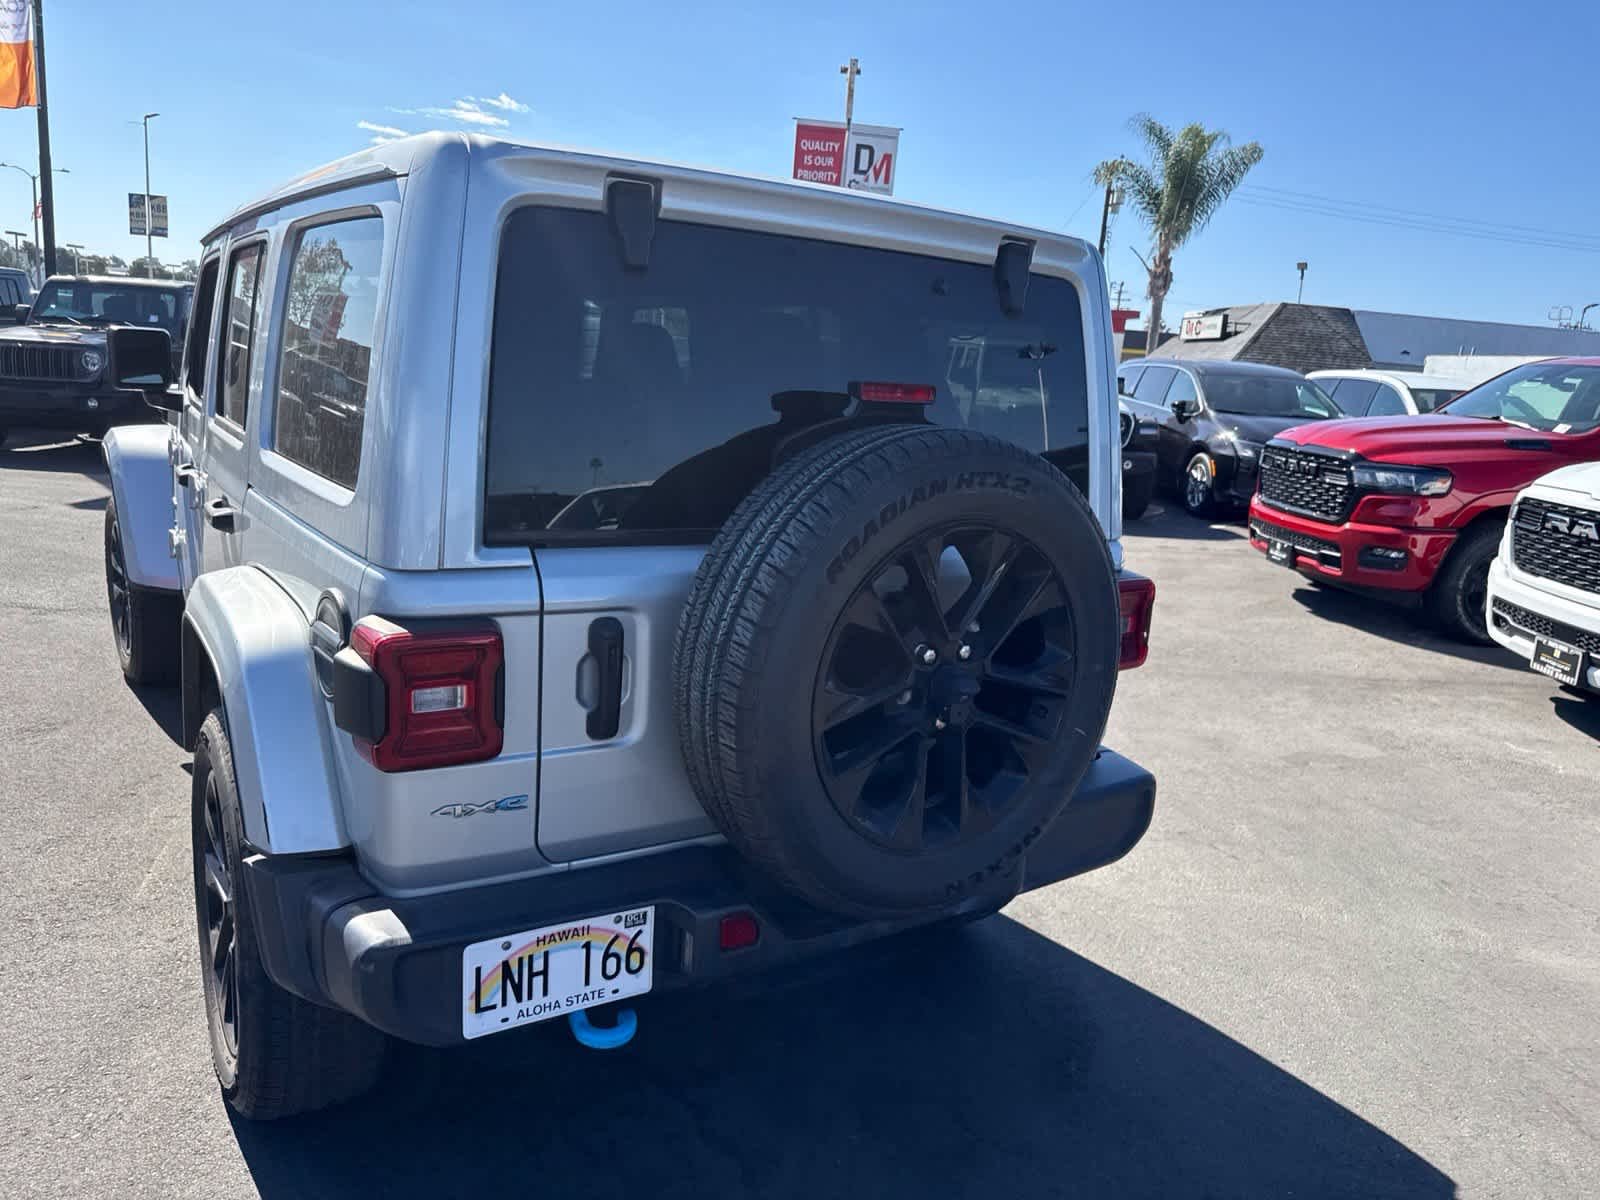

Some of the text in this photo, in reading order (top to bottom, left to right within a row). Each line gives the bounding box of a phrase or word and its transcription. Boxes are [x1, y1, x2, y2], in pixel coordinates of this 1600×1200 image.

[800, 139, 840, 153] QUALITY
[804, 154, 834, 167] IS OUR
[797, 168, 838, 184] PRIORITY
[1543, 511, 1600, 541] RA
[536, 925, 591, 948] HAWAII
[474, 929, 645, 1014] LNH 166
[517, 988, 606, 1020] ALOHA STATE
